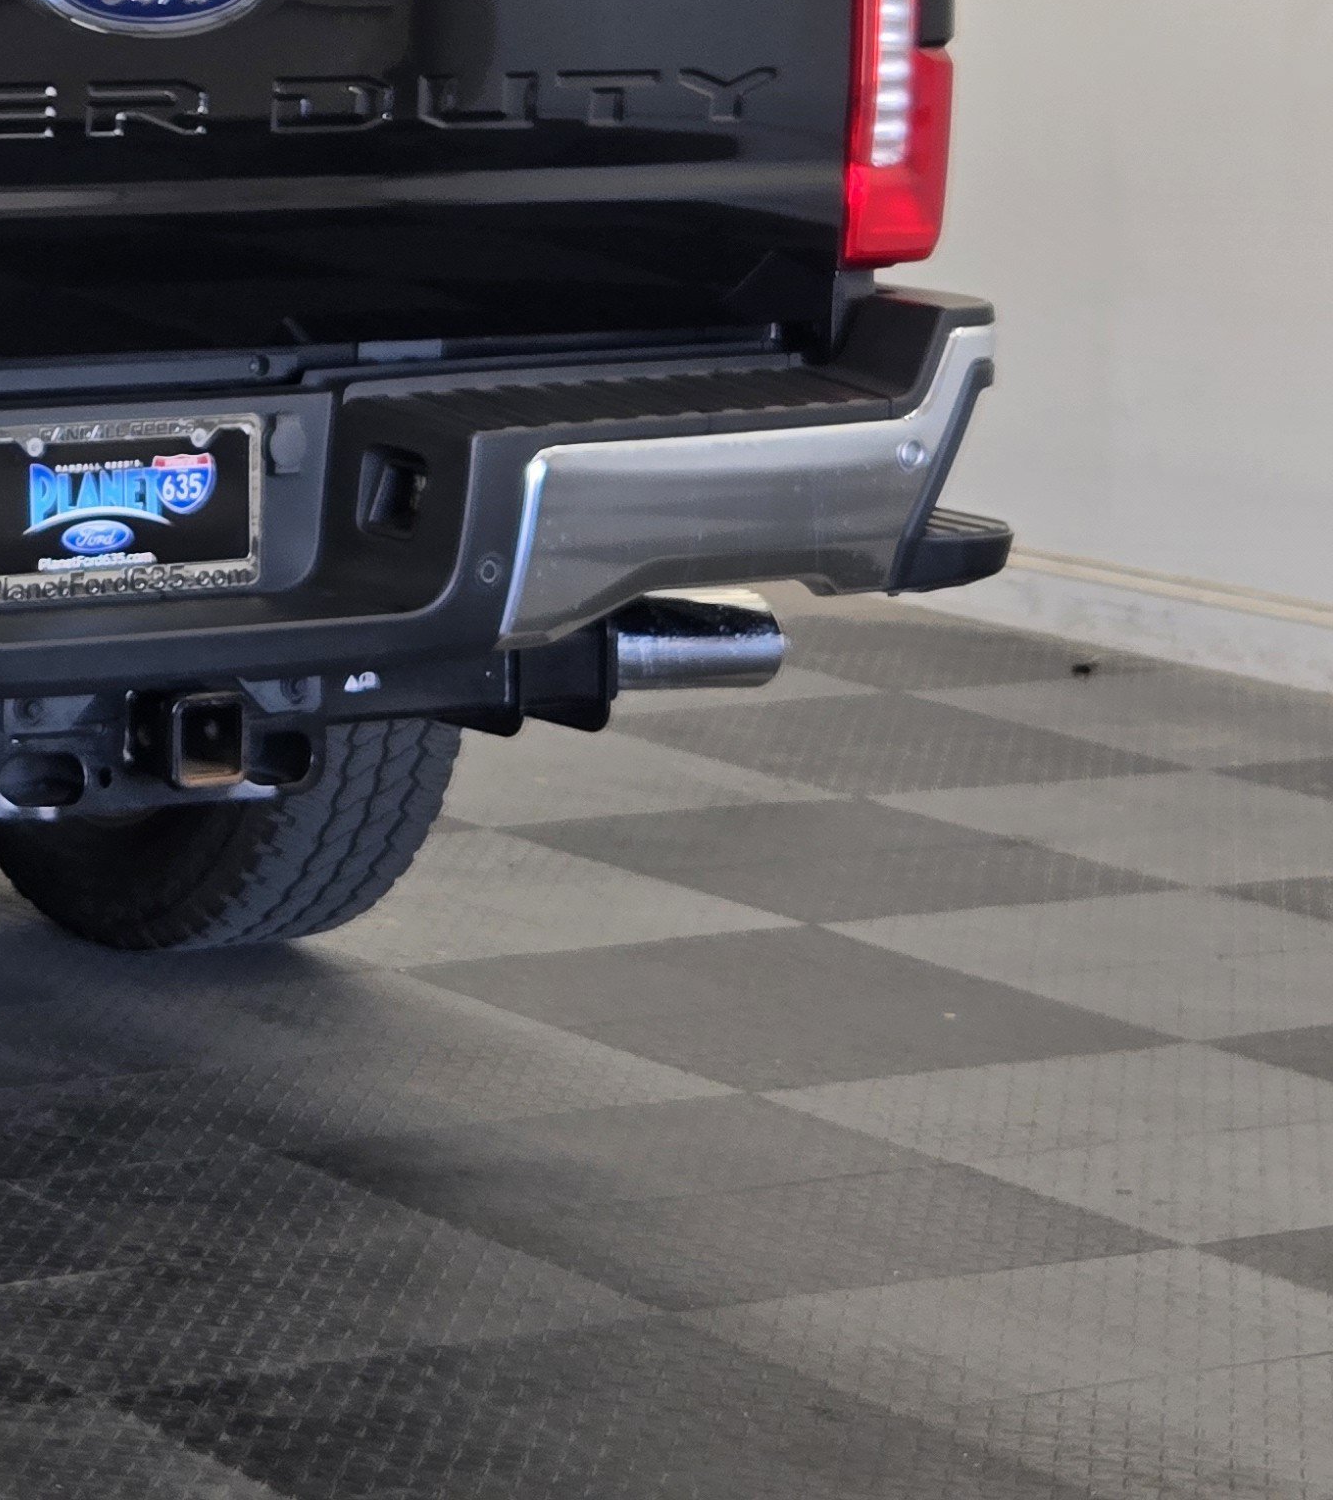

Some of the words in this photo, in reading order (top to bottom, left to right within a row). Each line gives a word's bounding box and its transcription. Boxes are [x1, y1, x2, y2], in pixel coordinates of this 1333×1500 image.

[270, 67, 778, 134] DUTY
[29, 463, 162, 529] PLANET
[162, 471, 203, 501] 635
[74, 526, 118, 548] Ford
